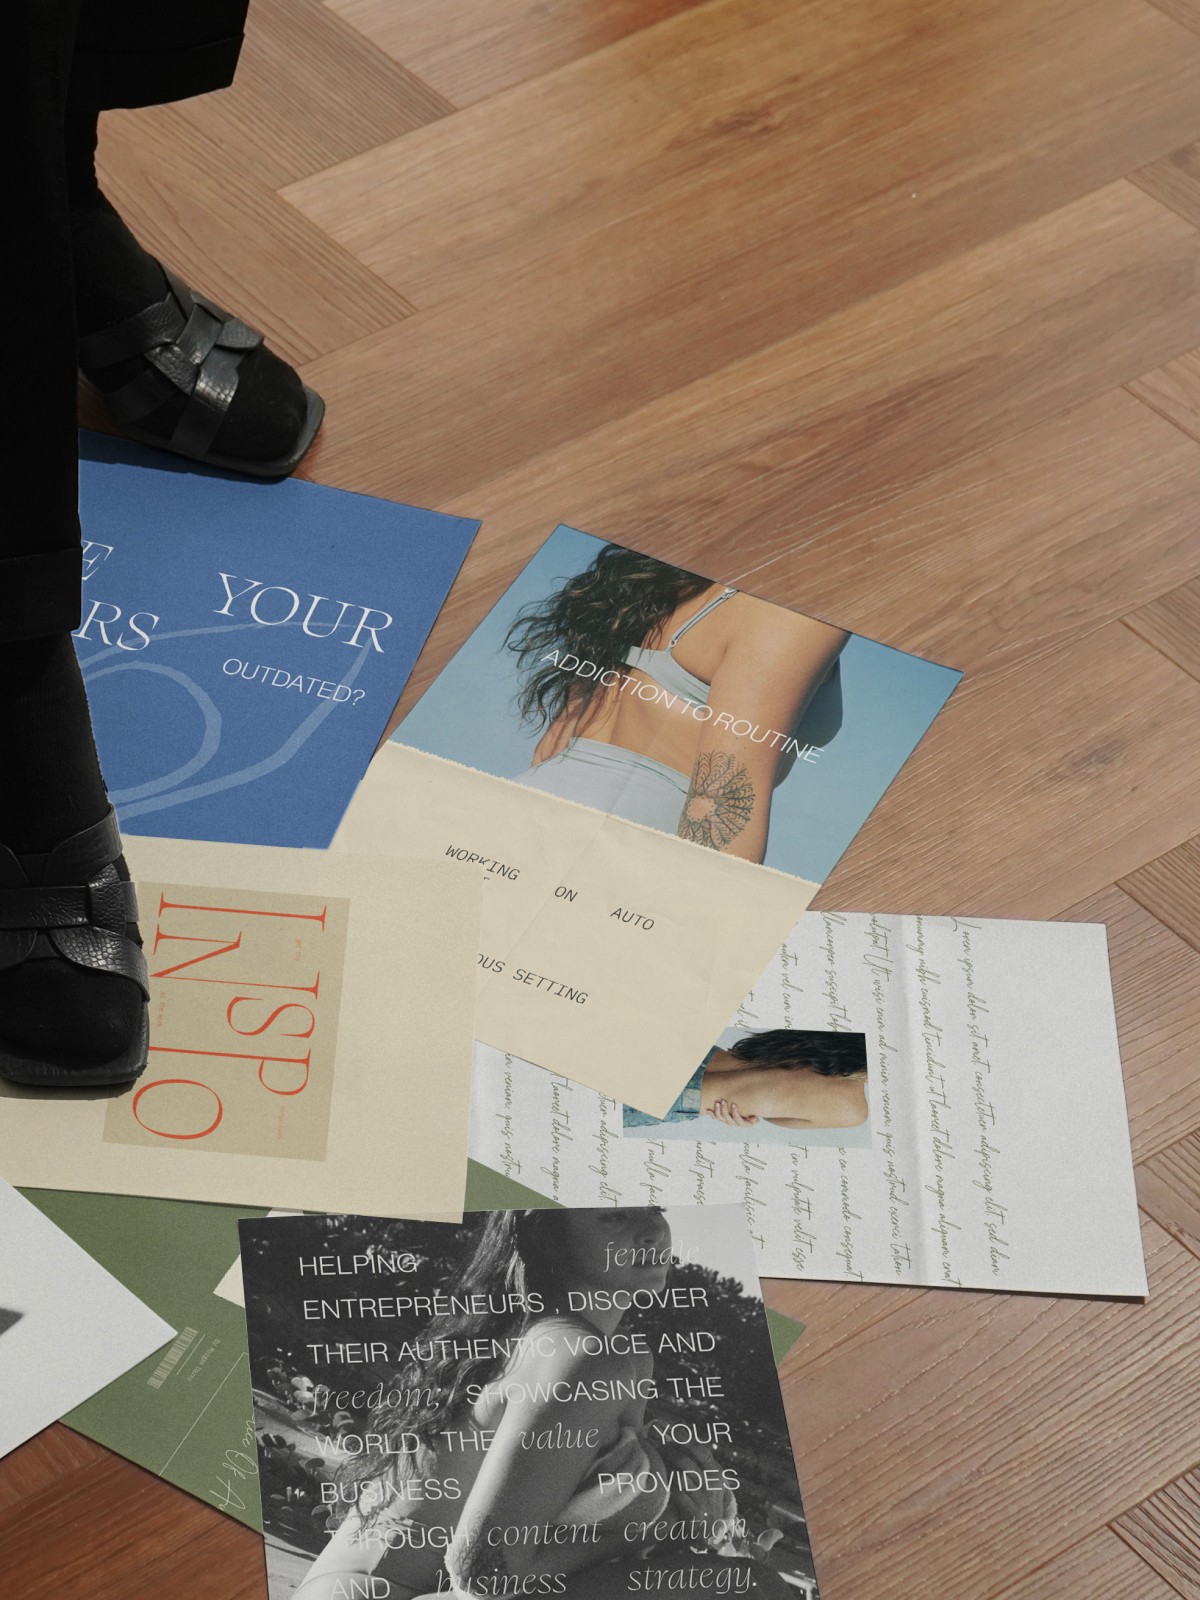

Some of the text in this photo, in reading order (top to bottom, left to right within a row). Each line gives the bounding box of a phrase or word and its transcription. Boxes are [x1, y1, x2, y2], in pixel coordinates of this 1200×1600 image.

[213, 572, 393, 653] YOUR
[222, 658, 366, 706] OUTDATED?
[540, 649, 825, 765] ADDICTION TO ROUTINE
[445, 844, 655, 931] WORKING ON AUTO
[951, 916, 982, 955] Lorem
[513, 968, 589, 1005] SETTING
[781, 972, 804, 993] vel
[915, 958, 941, 986] nibh
[957, 957, 975, 992] ipsum
[871, 979, 885, 1005] wisi
[919, 987, 943, 1032] euismod
[967, 991, 990, 1021] dolor
[874, 1007, 886, 1032] enim
[967, 1023, 988, 1048] sit
[878, 1034, 899, 1053] ad
[922, 1032, 946, 1090] tincidunt
[879, 1052, 890, 1087] minim
[495, 1114, 515, 1139] quis
[551, 1119, 573, 1154] dolore
[928, 1098, 952, 1143] laoreet
[588, 1119, 620, 1178] adipiscing
[877, 1131, 896, 1158] quis
[932, 1136, 956, 1172] dolore
[540, 1156, 560, 1192] magna
[972, 1133, 1000, 1194] adipiscing
[839, 1174, 862, 1223] commodo
[883, 1160, 909, 1206] nostrud
[925, 1174, 946, 1211] magna
[794, 1218, 817, 1253] velit
[930, 1212, 962, 1259] aliquam
[983, 1222, 1009, 1247] sed
[298, 1239, 701, 1276] HELPING female
[794, 1247, 808, 1272] esse
[890, 1241, 912, 1277] tation
[990, 1246, 1011, 1277] diam
[303, 1292, 545, 1320] ENTREPRENEURS
[568, 1287, 709, 1312] DISCOVER
[306, 1331, 716, 1365] THEIR AUTHENTIC VOICE AND
[466, 1378, 659, 1406] SHOWCASING
[666, 1376, 725, 1399] THE
[314, 1422, 733, 1457] WORLD THE value YOUR
[320, 1468, 741, 1504] BUSINESS PROVIDES
[324, 1512, 749, 1550] THROUGH content creation
[330, 1564, 758, 1600] AND business strategy.
